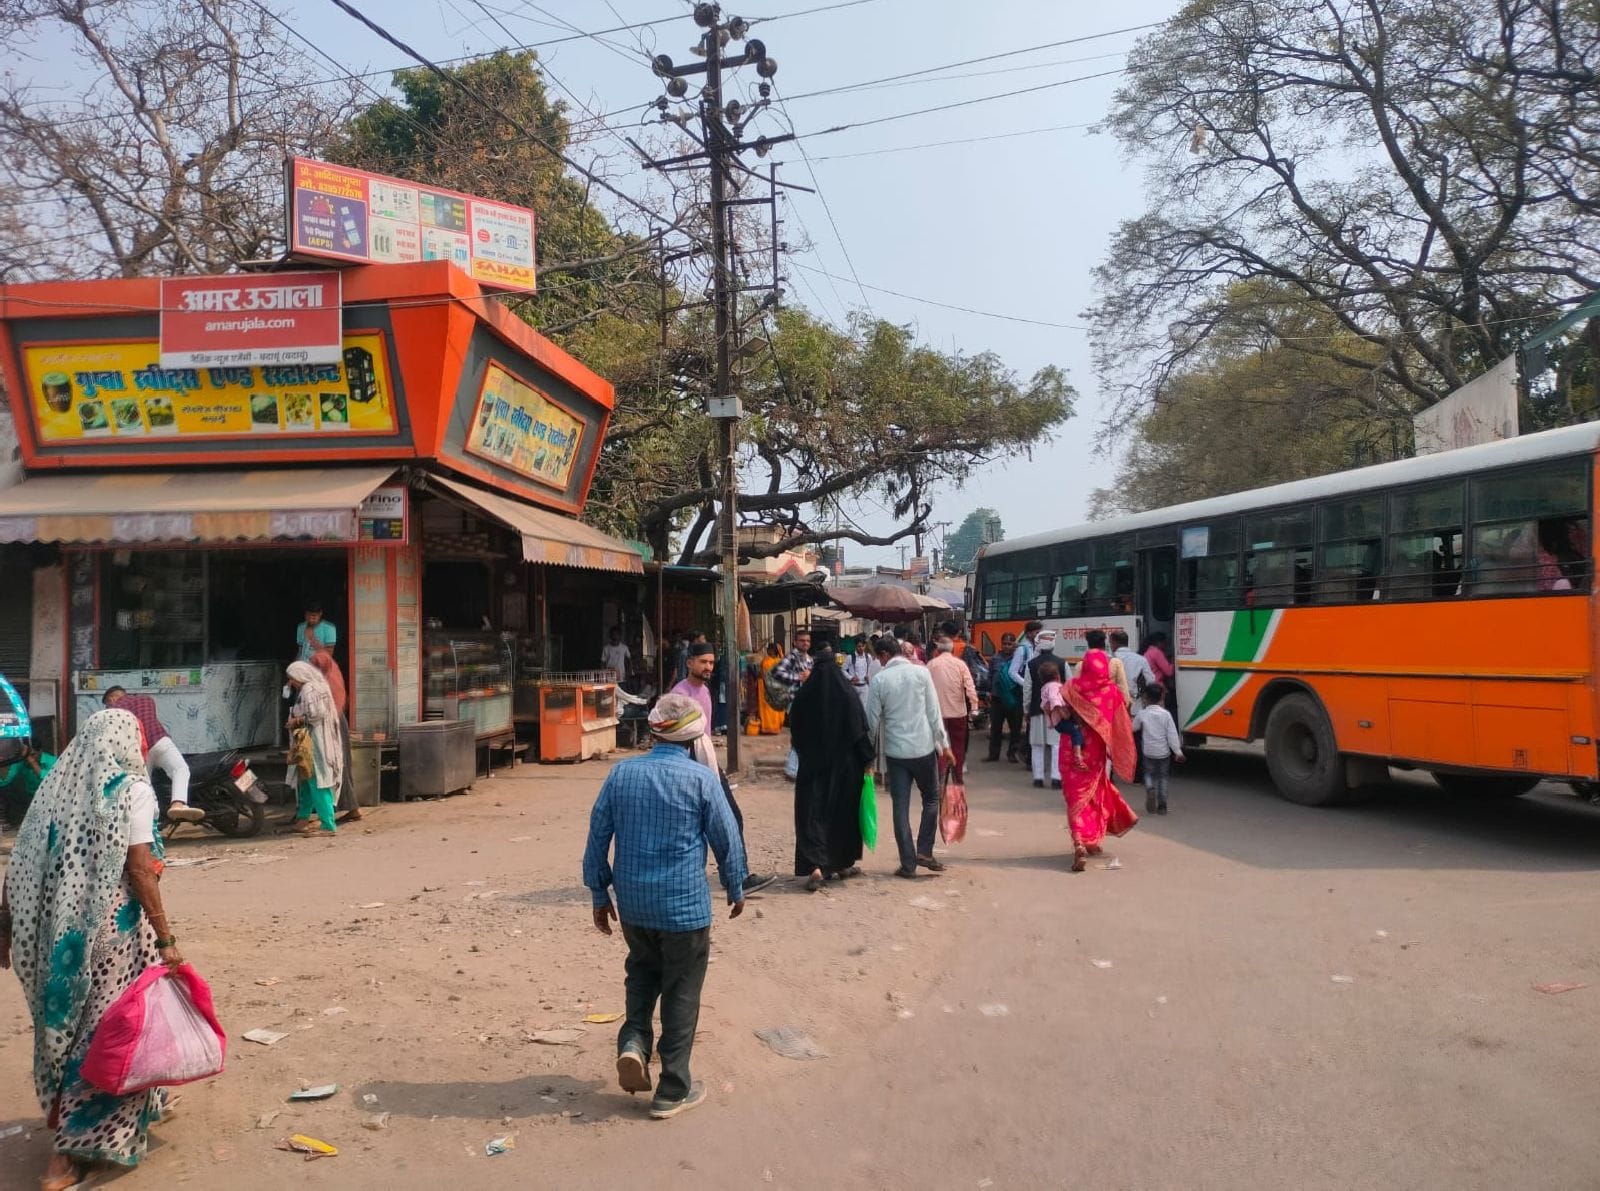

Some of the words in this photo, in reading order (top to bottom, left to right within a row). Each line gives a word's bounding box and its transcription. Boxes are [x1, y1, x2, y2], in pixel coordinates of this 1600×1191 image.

[475, 260, 530, 278] SAHAJ
[178, 289, 241, 312] अमर
[244, 285, 323, 310] उजाला
[204, 317, 295, 333] amarujala.com
[75, 371, 127, 398] गुप्ता
[370, 494, 401, 503] Fino
[1062, 627, 1077, 641] उत्तर
